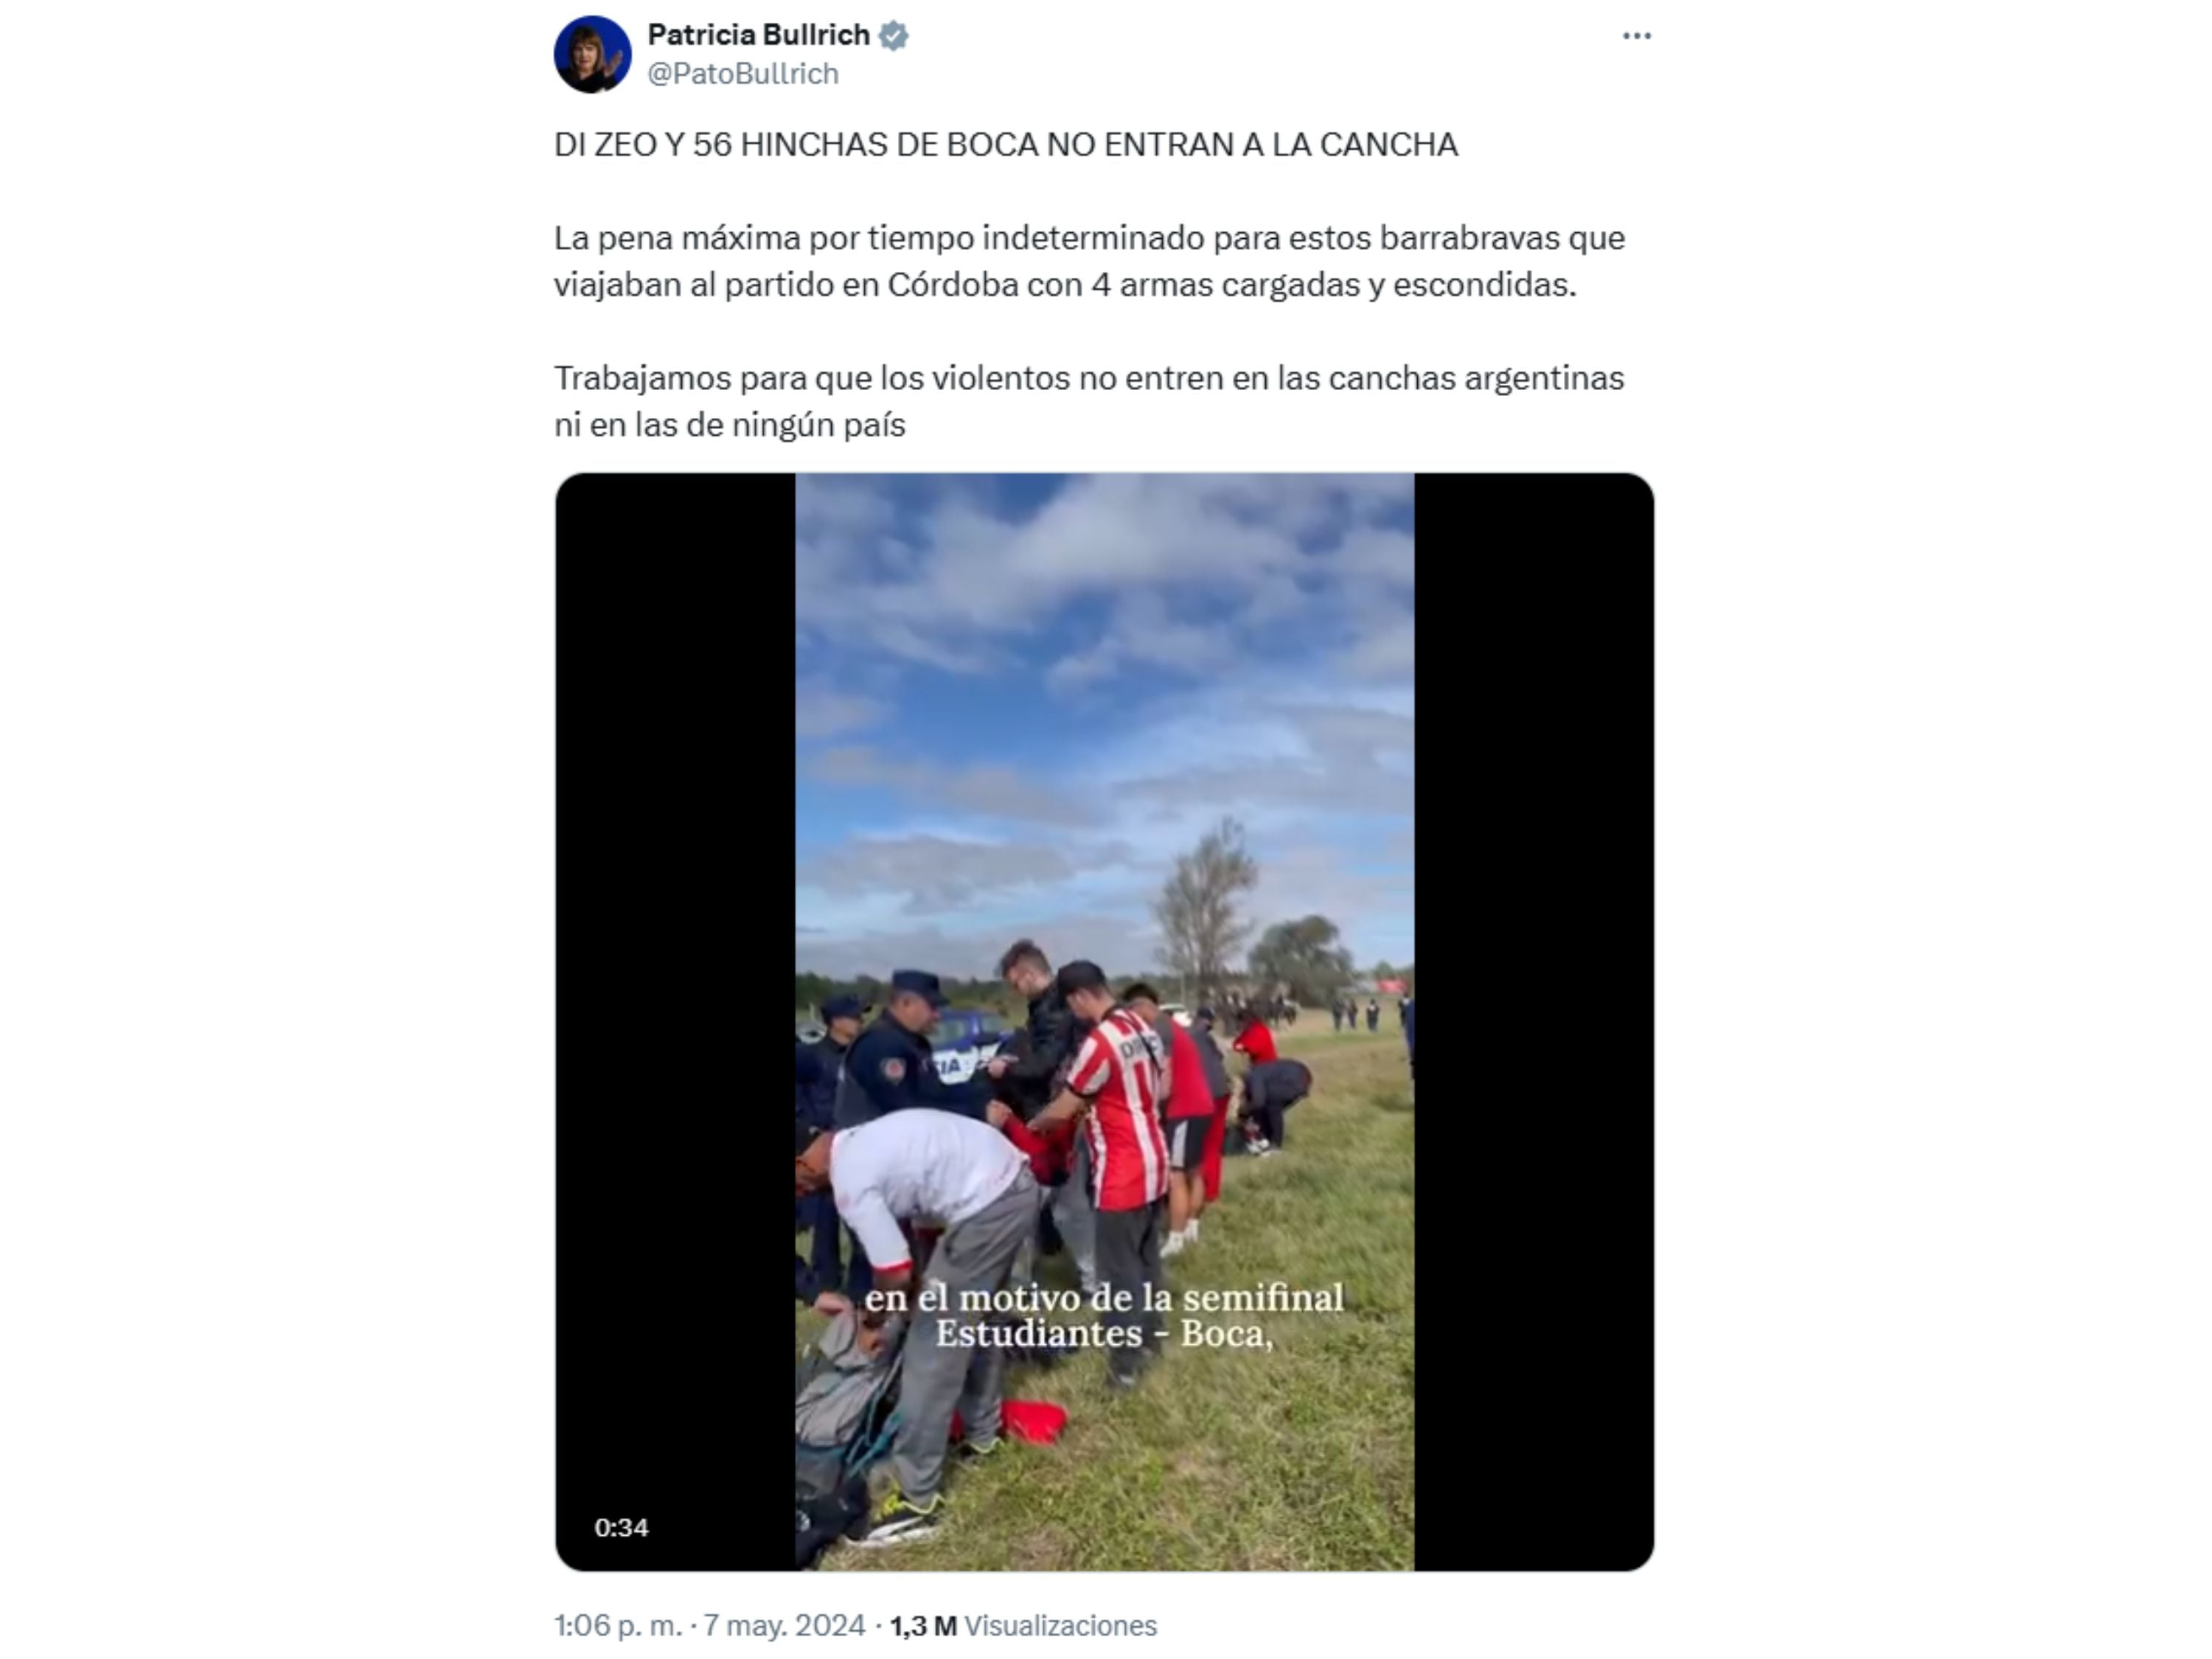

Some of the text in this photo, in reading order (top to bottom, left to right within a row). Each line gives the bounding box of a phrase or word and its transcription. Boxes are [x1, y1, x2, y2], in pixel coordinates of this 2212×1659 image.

[649, 23, 870, 46] Patricia Bullrich
[649, 62, 838, 86] @PatoBullrich
[556, 132, 1459, 156] DI ZEO Y 56 HINCHAS DE BOCA NO ENTRAN A LA CANCHA
[556, 223, 1625, 256] La pena máxima por tiempo indeterminado para estos barrabravas que
[554, 270, 1576, 302] viajaban al partido en Córdoba con 4 armas cargadas y escondidas.
[554, 364, 1624, 396] Trabajamos para que los violentos no entren en las canchas argentinas
[556, 411, 905, 442] ni en las de ningún país
[595, 1519, 649, 1537] 0:34
[555, 1614, 1158, 1642] 1:06 p. m. 7 may. 2024 1,3 M Visualizaciones
